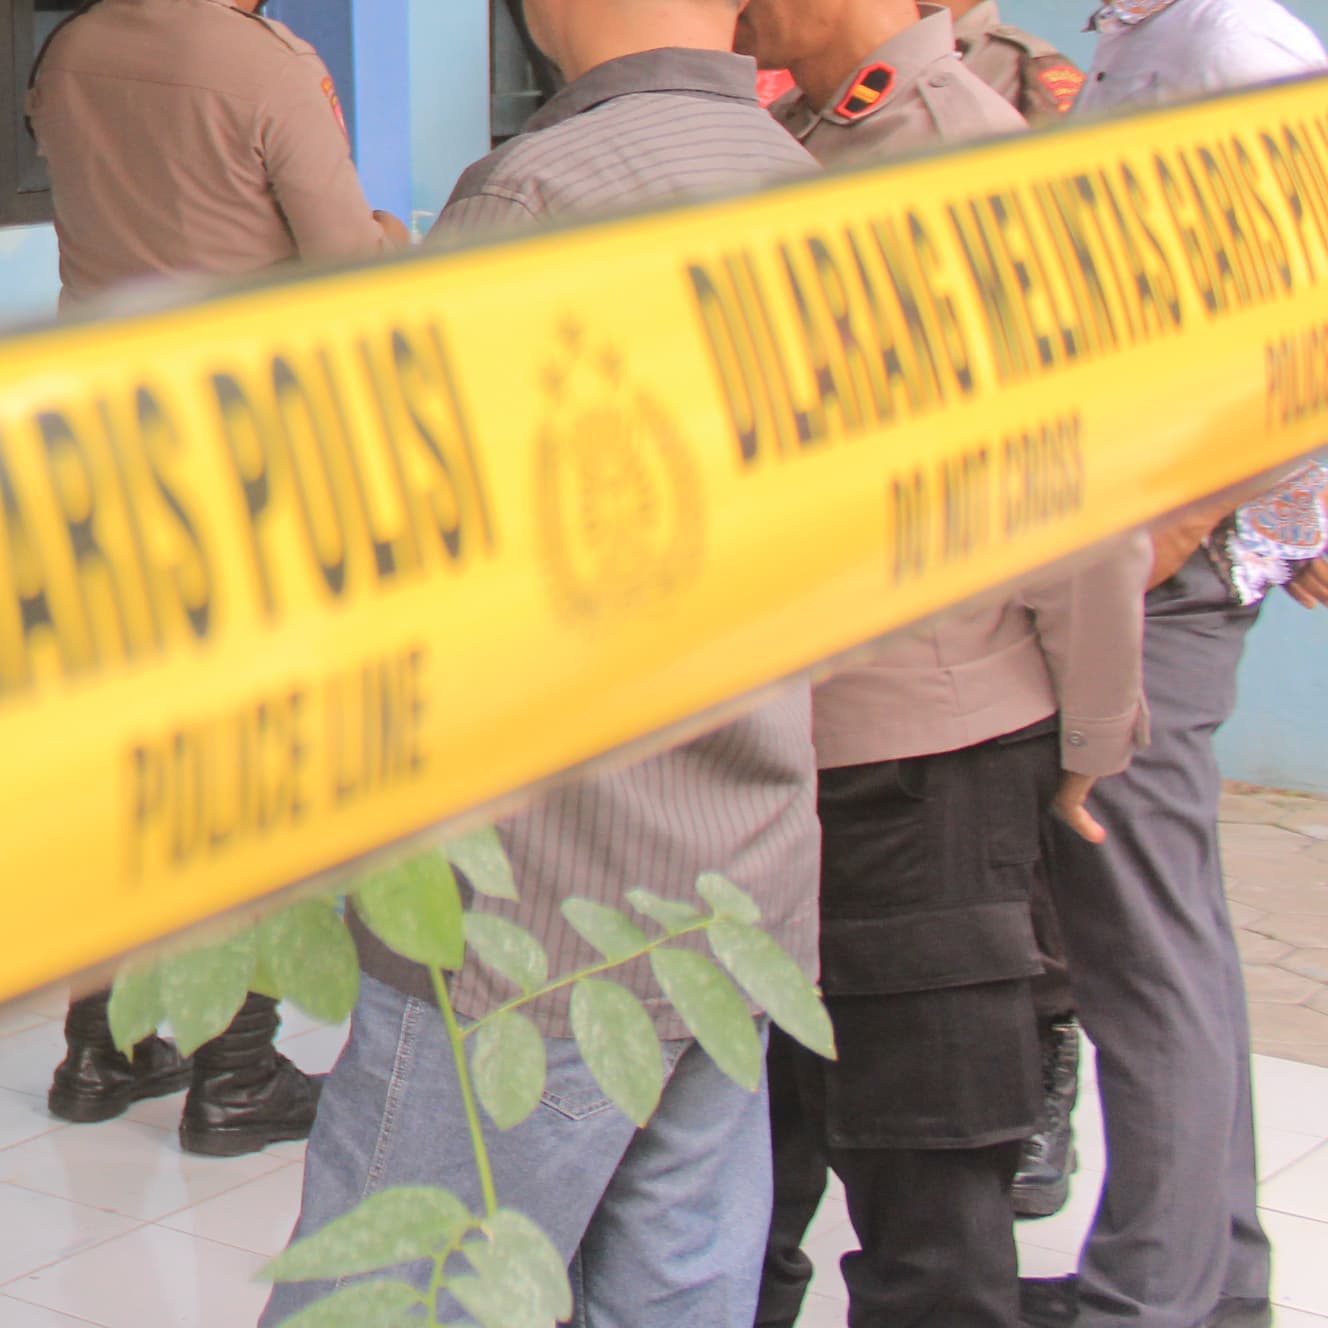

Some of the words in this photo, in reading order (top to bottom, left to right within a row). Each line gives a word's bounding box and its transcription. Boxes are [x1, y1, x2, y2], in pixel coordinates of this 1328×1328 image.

[686, 209, 973, 463] DILARANG
[946, 160, 1183, 388] MELINTAS
[1151, 135, 1294, 318] GARIS
[211, 320, 498, 624] POLISI
[128, 689, 310, 886] POLICE
